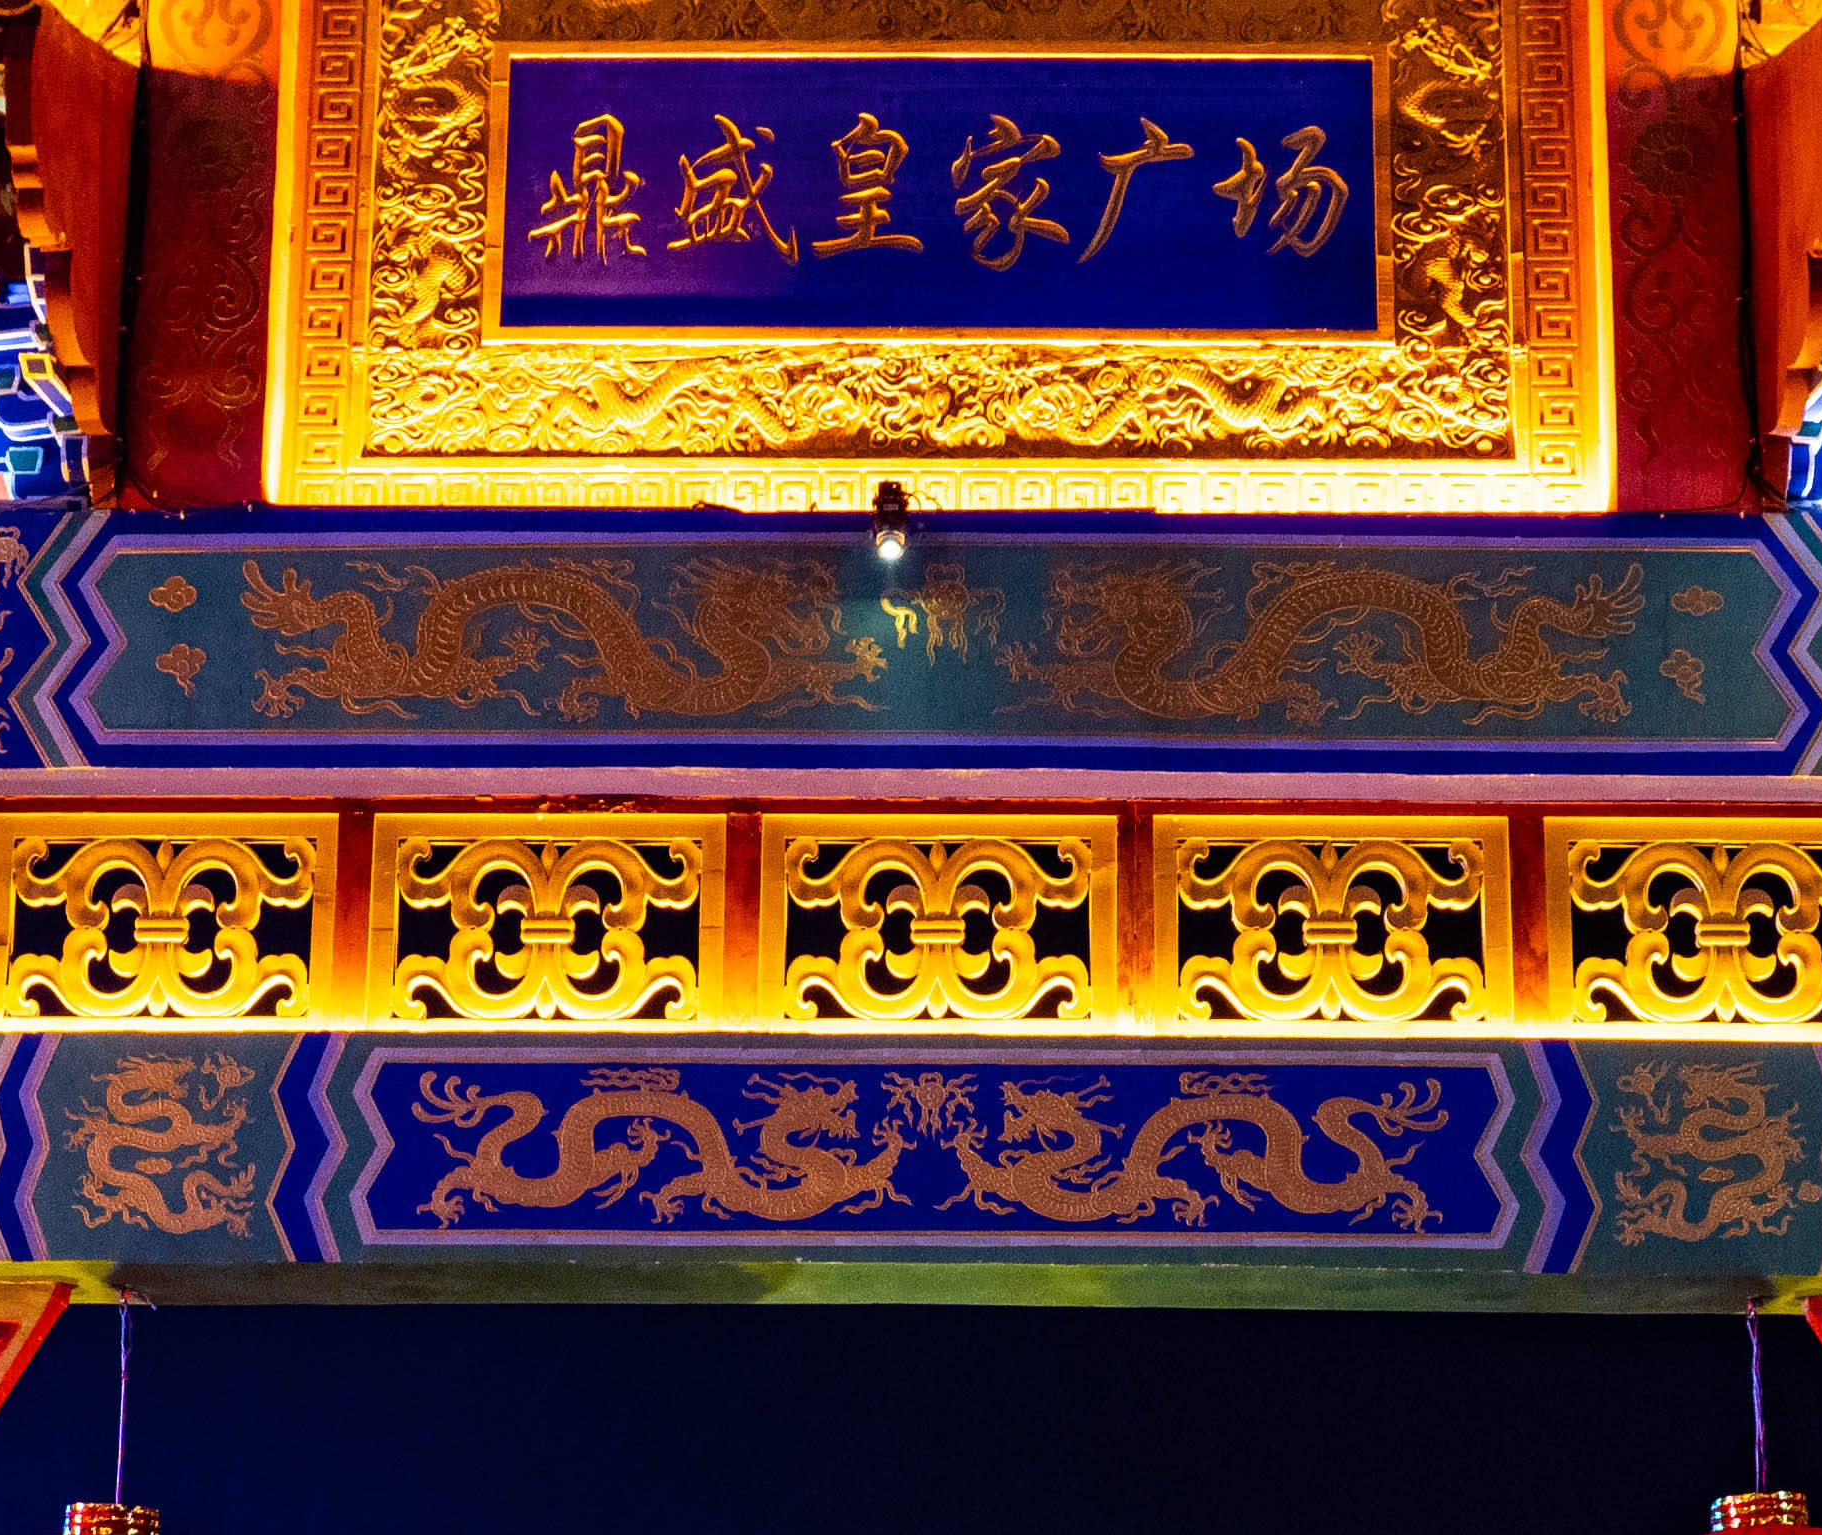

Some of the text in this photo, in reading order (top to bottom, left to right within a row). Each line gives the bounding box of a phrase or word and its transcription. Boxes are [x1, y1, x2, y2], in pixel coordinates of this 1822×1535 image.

[528, 112, 1349, 271] 鼎盛皇家广场
